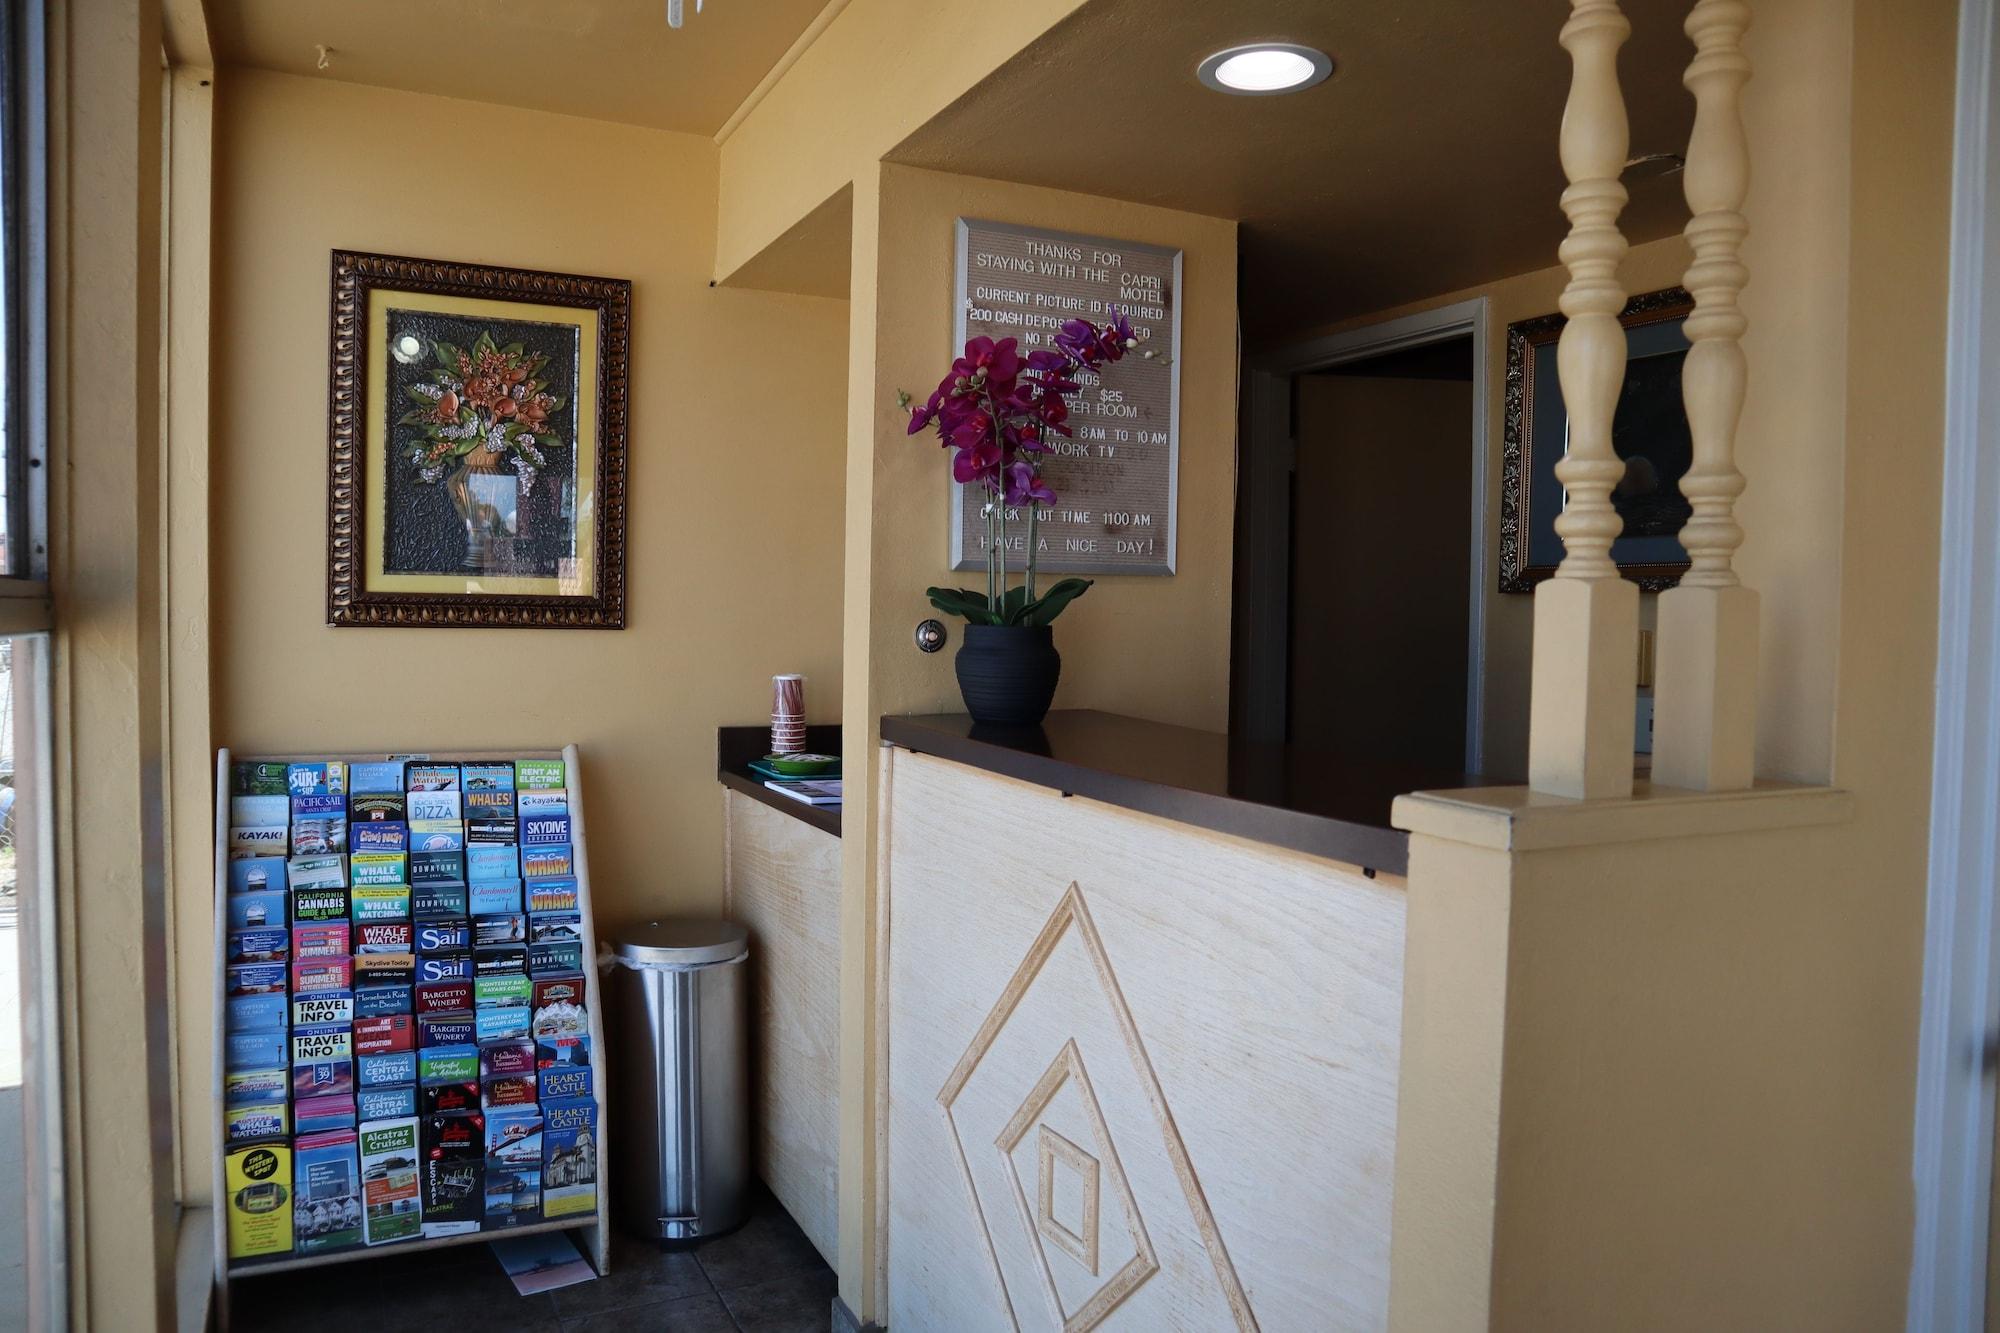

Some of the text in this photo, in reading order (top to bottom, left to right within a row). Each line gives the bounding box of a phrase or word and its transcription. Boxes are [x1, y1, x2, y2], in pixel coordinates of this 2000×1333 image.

[1026, 241, 1122, 267] THANKS FOR
[977, 253, 1162, 289] STAYING WITH THE CAPRI
[976, 286, 1030, 305] CURRENT
[1036, 293, 1085, 311] PICTURE
[1090, 299, 1101, 312] ID
[1120, 287, 1164, 304] MOTEL
[995, 311, 1022, 325] CASH
[1025, 332, 1040, 345] NO
[1100, 388, 1123, 403] $25
[1065, 401, 1137, 418] PER ROOM
[1115, 429, 1129, 442] TO
[1137, 431, 1148, 443] 10
[1151, 433, 1167, 445] AM
[1099, 445, 1115, 458] TV
[1061, 511, 1090, 523] TIME
[1104, 512, 1129, 525] 1100
[1134, 514, 1151, 526] AM
[1038, 537, 1048, 551] A
[1066, 538, 1097, 552] NICE
[521, 768, 544, 776] RENT
[291, 771, 320, 788] SURF
[293, 796, 342, 807] PACIFIC SAIL
[468, 793, 512, 806] WHALES!
[414, 806, 453, 819] PIZZA
[527, 821, 567, 834] SKYDIVE
[238, 832, 282, 840] KAYAK!
[359, 866, 397, 876] WHALE
[413, 864, 457, 873] DOWNTOWN
[525, 859, 569, 876] WHARF
[354, 874, 401, 885] WATCHING
[298, 892, 345, 900] CALIFORNIA
[530, 893, 576, 911] WHARF
[298, 898, 345, 910] CANNABIS
[364, 901, 401, 911] WHALE
[416, 899, 460, 908] DOWNTOWN
[298, 909, 319, 917] GUIDE
[327, 908, 345, 916] MAP
[358, 910, 405, 919] WATCHING
[364, 928, 408, 937] WHALE
[328, 938, 342, 946] FREE
[366, 935, 404, 945] WATCH
[421, 929, 461, 950] Sail
[299, 946, 335, 957] SUMMER
[532, 954, 575, 965] DOWNTOWN
[328, 966, 342, 974] FREE
[423, 960, 464, 981] Sail
[299, 973, 335, 985] SUMMER
[422, 989, 467, 1000] BARGETTO
[299, 1000, 347, 1012] TRAVEL
[379, 1000, 402, 1008] Beach
[428, 998, 461, 1007] WINERY
[301, 1011, 335, 1022] INFO
[307, 1028, 338, 1036] ONLINE
[430, 1025, 471, 1033] BARGETTO
[296, 1035, 346, 1047] TRAVEL
[357, 1040, 392, 1049] INSPIRATION
[298, 1047, 333, 1058] INFO
[367, 1057, 409, 1068] California's
[317, 1070, 330, 1080] 39
[365, 1065, 411, 1076] CENTRAL
[371, 1073, 404, 1082] COAST
[544, 1072, 587, 1086] HEARST
[548, 1082, 587, 1095] CASTLE
[364, 1093, 406, 1103] California's
[362, 1100, 409, 1111] CENTRAL
[368, 1107, 401, 1117] COAST
[548, 1107, 592, 1119] HEARST
[239, 1119, 273, 1130] WHALE
[551, 1117, 591, 1129] CASTLE
[231, 1126, 280, 1138] WATCHING
[366, 1128, 409, 1143] Alcatraz
[369, 1137, 407, 1150] Cruises
[244, 1156, 275, 1173] MYSTERY
[248, 1153, 263, 1165] THE
[253, 1164, 273, 1177] SPOT
[429, 1160, 438, 1205] ESCAPE
